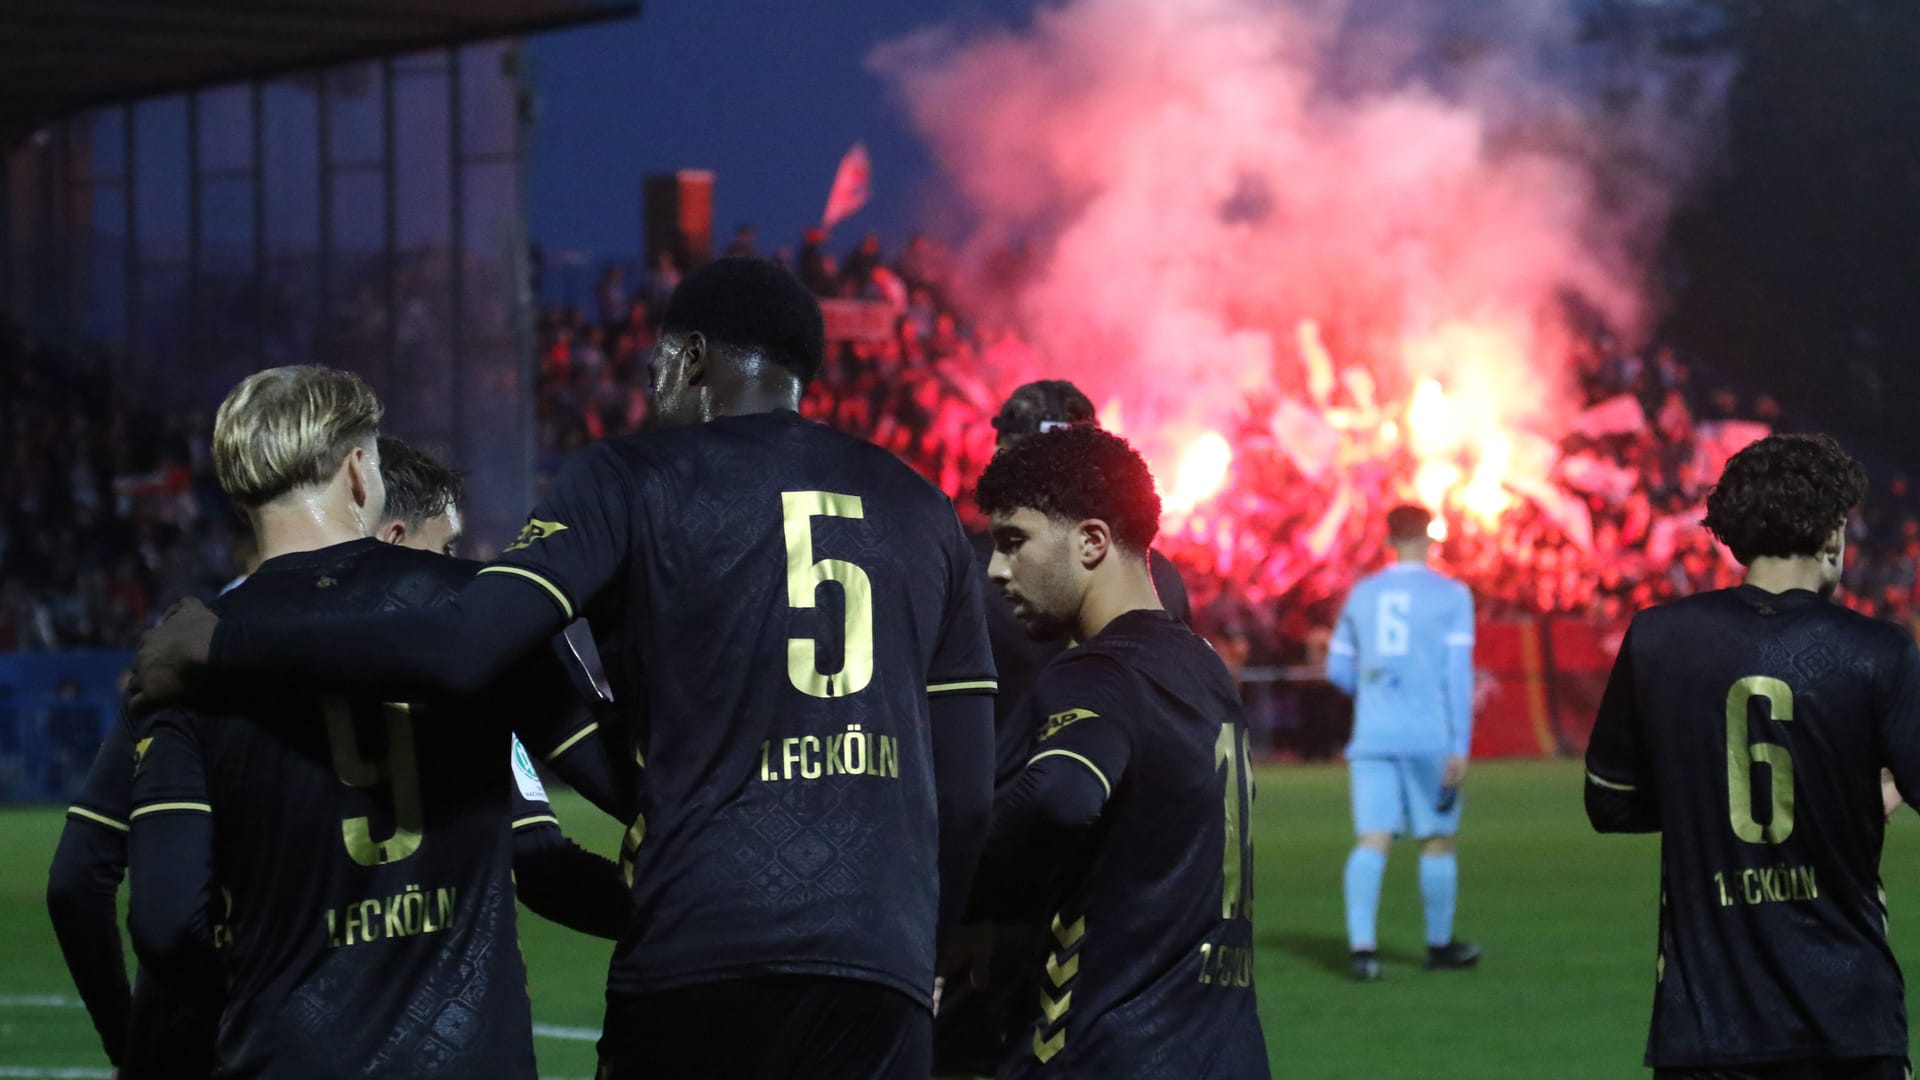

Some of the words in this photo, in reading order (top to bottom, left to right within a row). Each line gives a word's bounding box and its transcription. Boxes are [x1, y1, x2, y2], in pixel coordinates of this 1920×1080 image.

[781, 490, 874, 698] 5
[1376, 590, 1411, 656] 6
[320, 692, 424, 868] 9
[825, 723, 899, 779] KÖLN
[1726, 675, 1795, 845] 6
[385, 883, 456, 938] KÖLN
[1759, 862, 1818, 902] KÖLN
